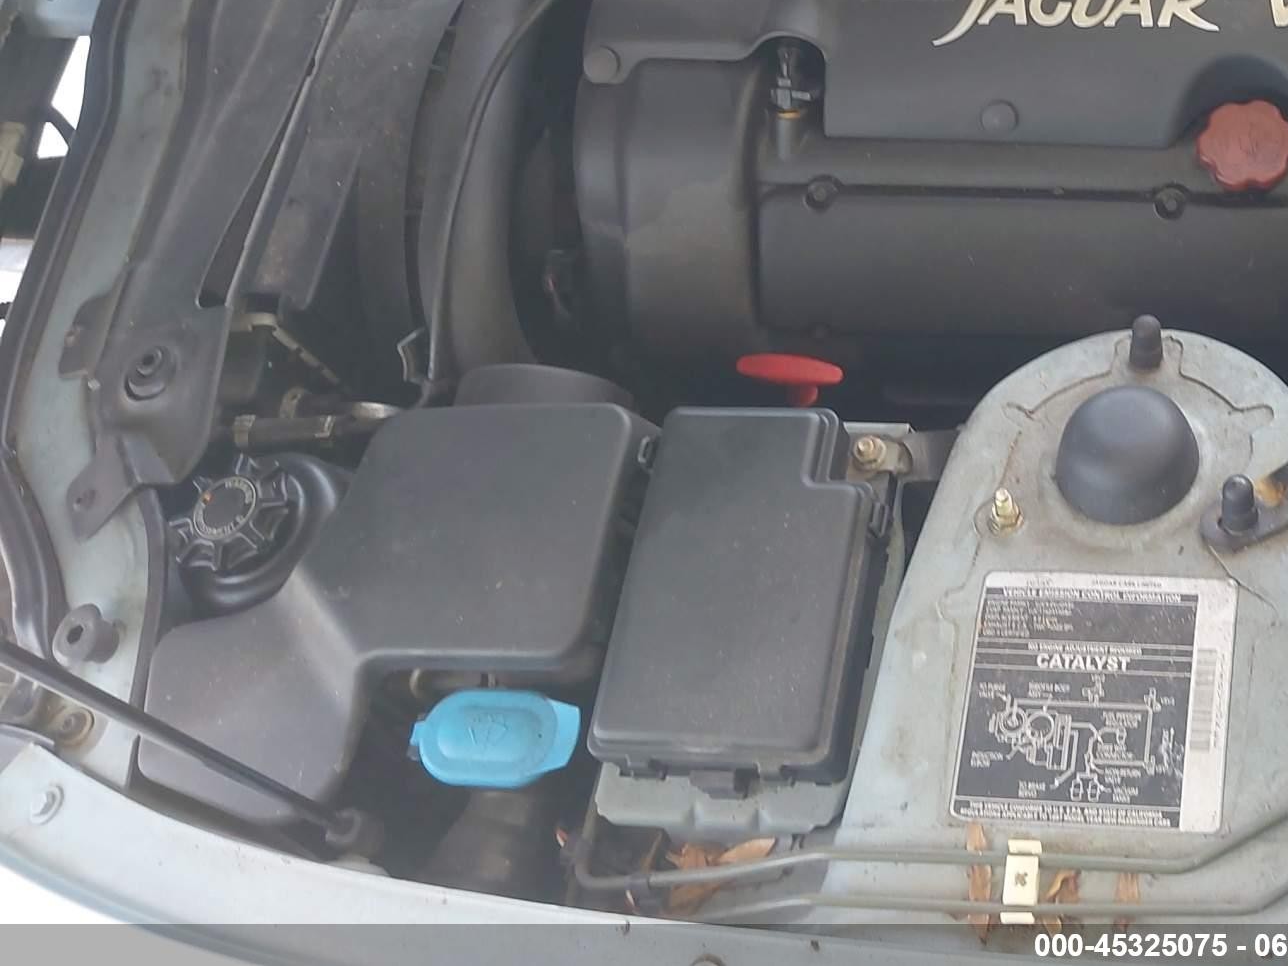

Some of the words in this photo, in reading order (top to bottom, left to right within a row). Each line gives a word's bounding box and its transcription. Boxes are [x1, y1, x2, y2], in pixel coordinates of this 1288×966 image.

[1003, 586, 1035, 597] VEHICLE
[1039, 588, 1079, 599] EMISSION
[1082, 590, 1120, 601] CONTROL
[1122, 592, 1181, 603] INFORMATION
[1039, 644, 1061, 652] ENGINE
[1064, 645, 1106, 653] ADJUSTMENT
[1037, 653, 1131, 671] CATALYST
[1127, 808, 1162, 818] CALIFORNIA
